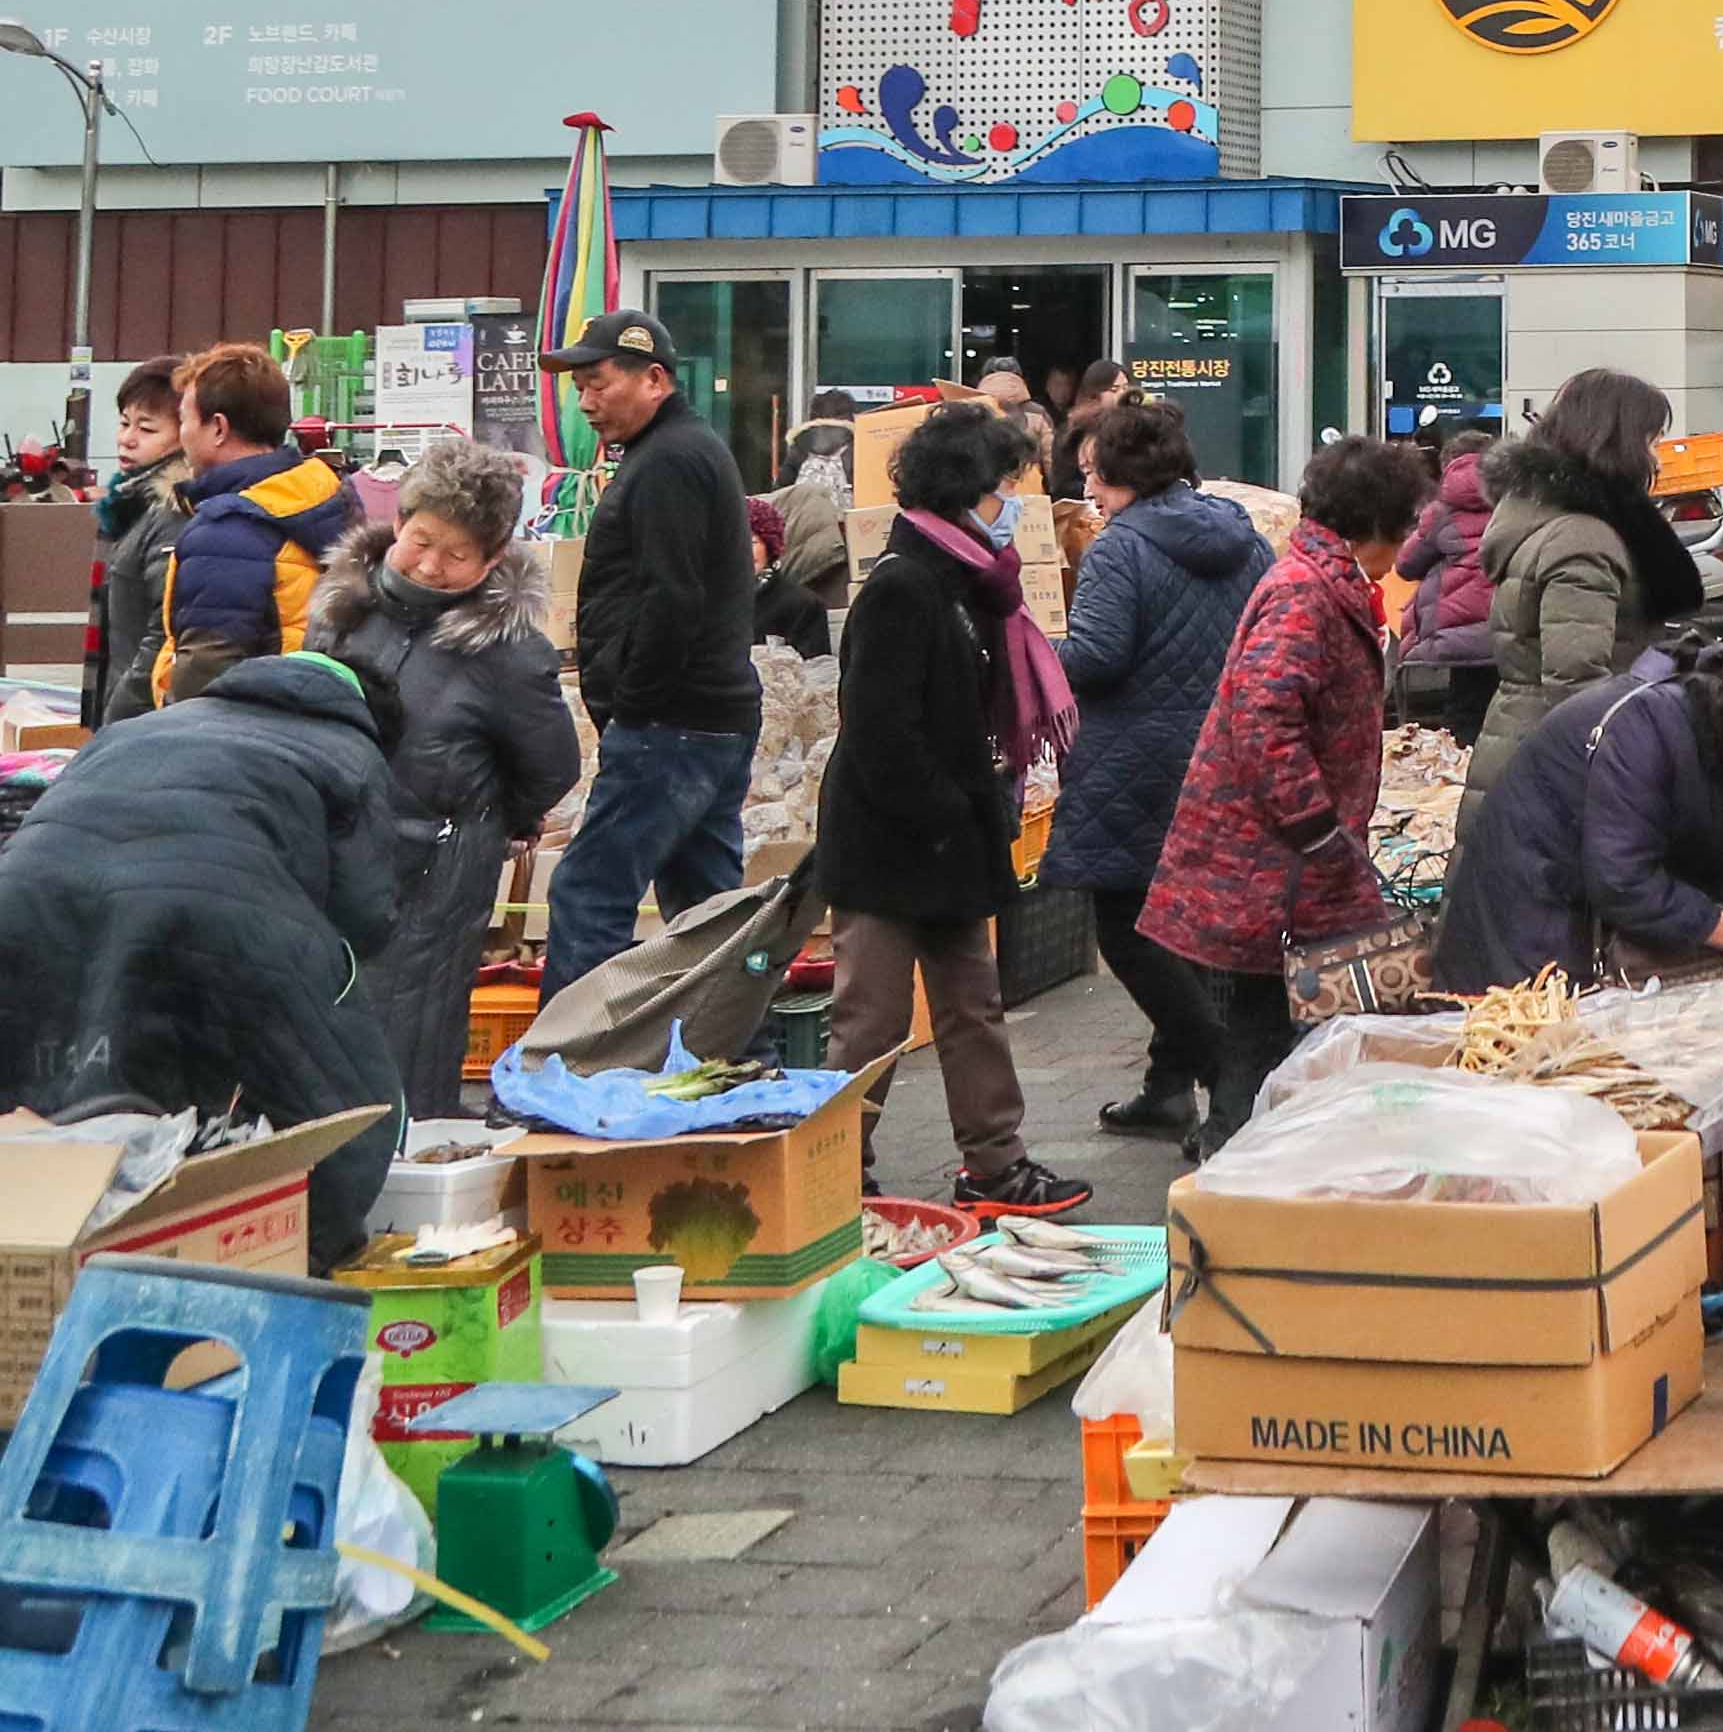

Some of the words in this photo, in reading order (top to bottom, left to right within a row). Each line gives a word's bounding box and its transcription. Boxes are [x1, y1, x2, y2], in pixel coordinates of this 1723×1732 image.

[87, 26, 151, 45] 수산시장
[204, 25, 233, 45] 2F
[324, 22, 358, 43] 카페
[246, 86, 303, 104] FOOD
[306, 84, 372, 103] COURT
[1439, 217, 1498, 250] MG
[1565, 231, 1601, 252] 365
[1603, 232, 1636, 251] 코너
[1131, 358, 1231, 379] 당진전통시장
[1250, 1415, 1351, 1455] MADE
[1357, 1420, 1392, 1455] IN
[1401, 1423, 1512, 1460] CHINA
